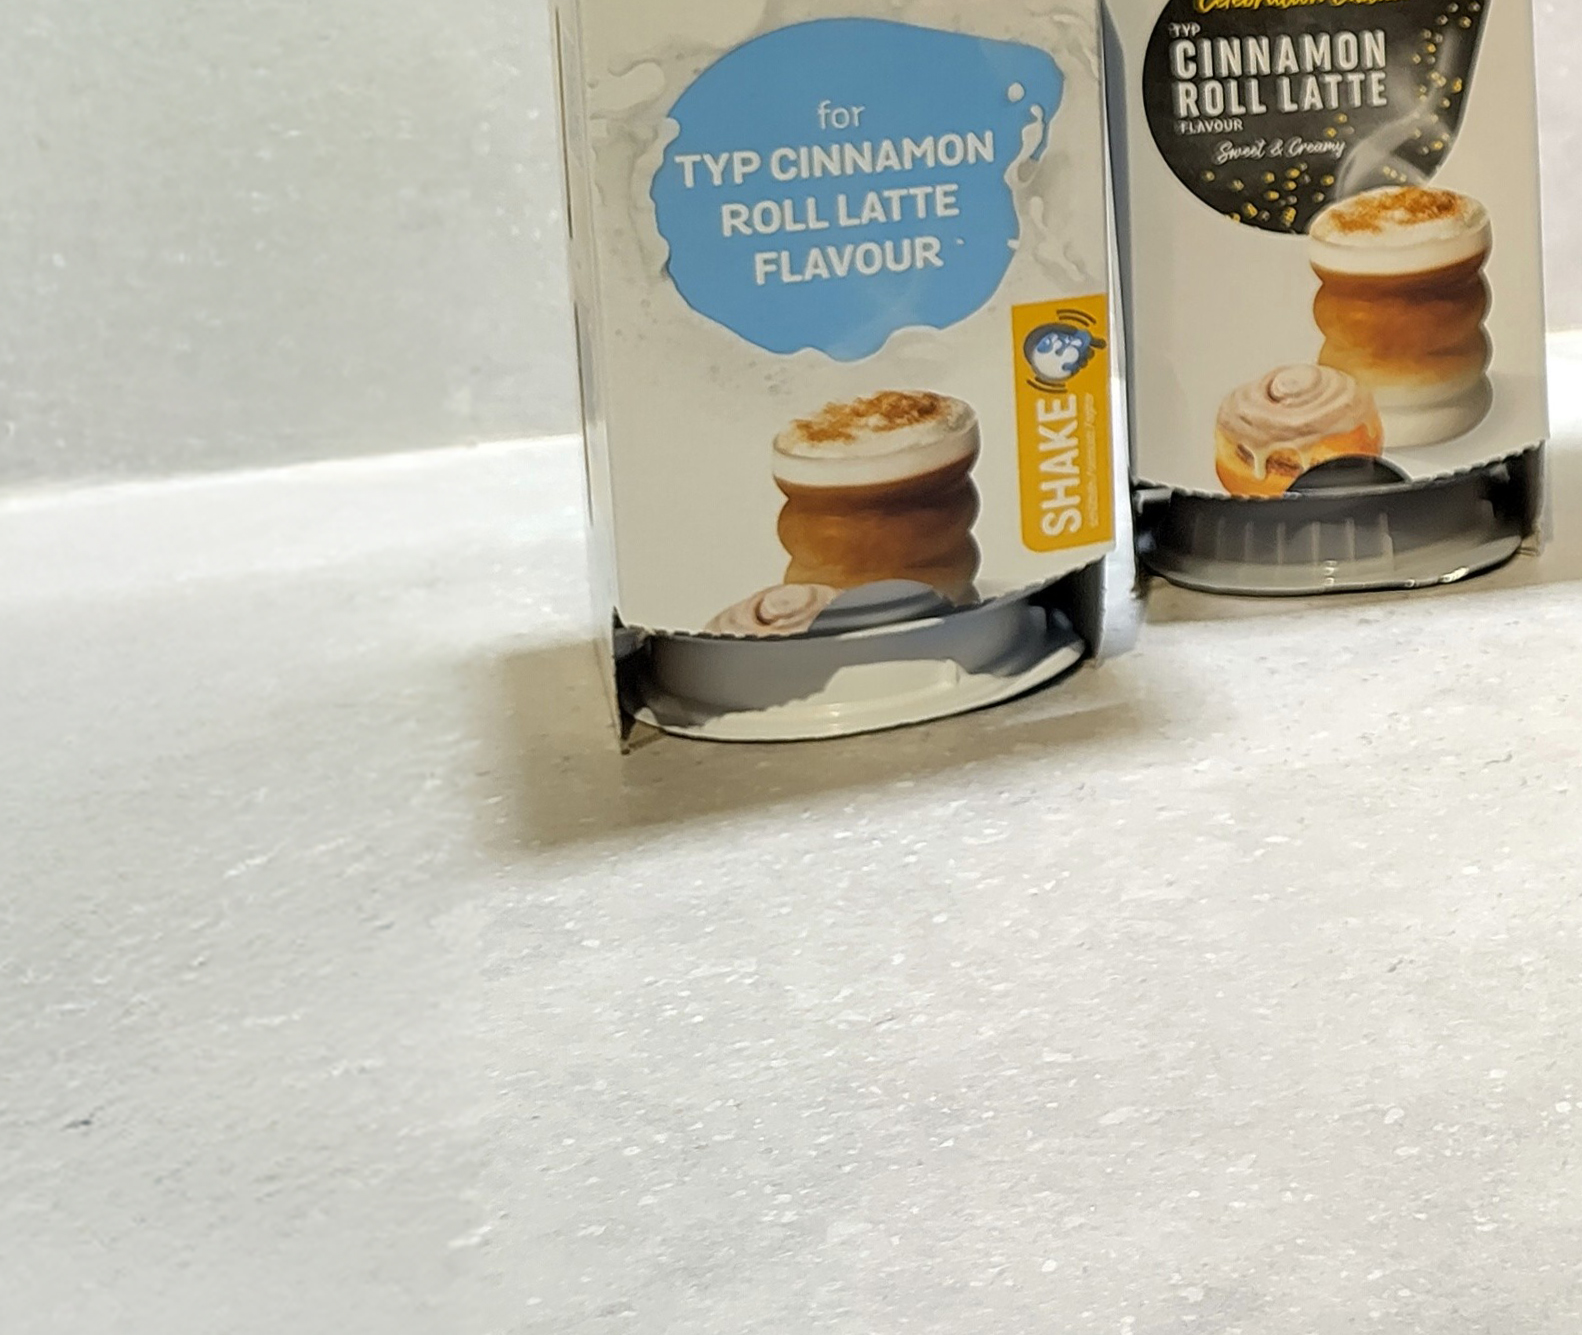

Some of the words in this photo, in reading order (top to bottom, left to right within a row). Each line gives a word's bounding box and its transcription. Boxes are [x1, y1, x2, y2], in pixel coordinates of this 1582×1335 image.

[1171, 22, 1201, 37] TYP
[1170, 29, 1387, 79] CINNAMON
[817, 100, 865, 130] for
[1173, 76, 1267, 118] ROLL
[1277, 71, 1388, 114] LATTE
[1177, 119, 1243, 134] FLAVOUR
[1216, 139, 1265, 163] Sweet
[1270, 139, 1284, 156] &
[1288, 136, 1346, 160] Creamy
[674, 150, 760, 188] TYP
[770, 131, 995, 181] CINNAMON
[720, 201, 829, 237] ROLL
[838, 184, 960, 227] LATTE
[753, 236, 944, 285] FLAVOUR
[1035, 393, 1082, 537] SHAKE
